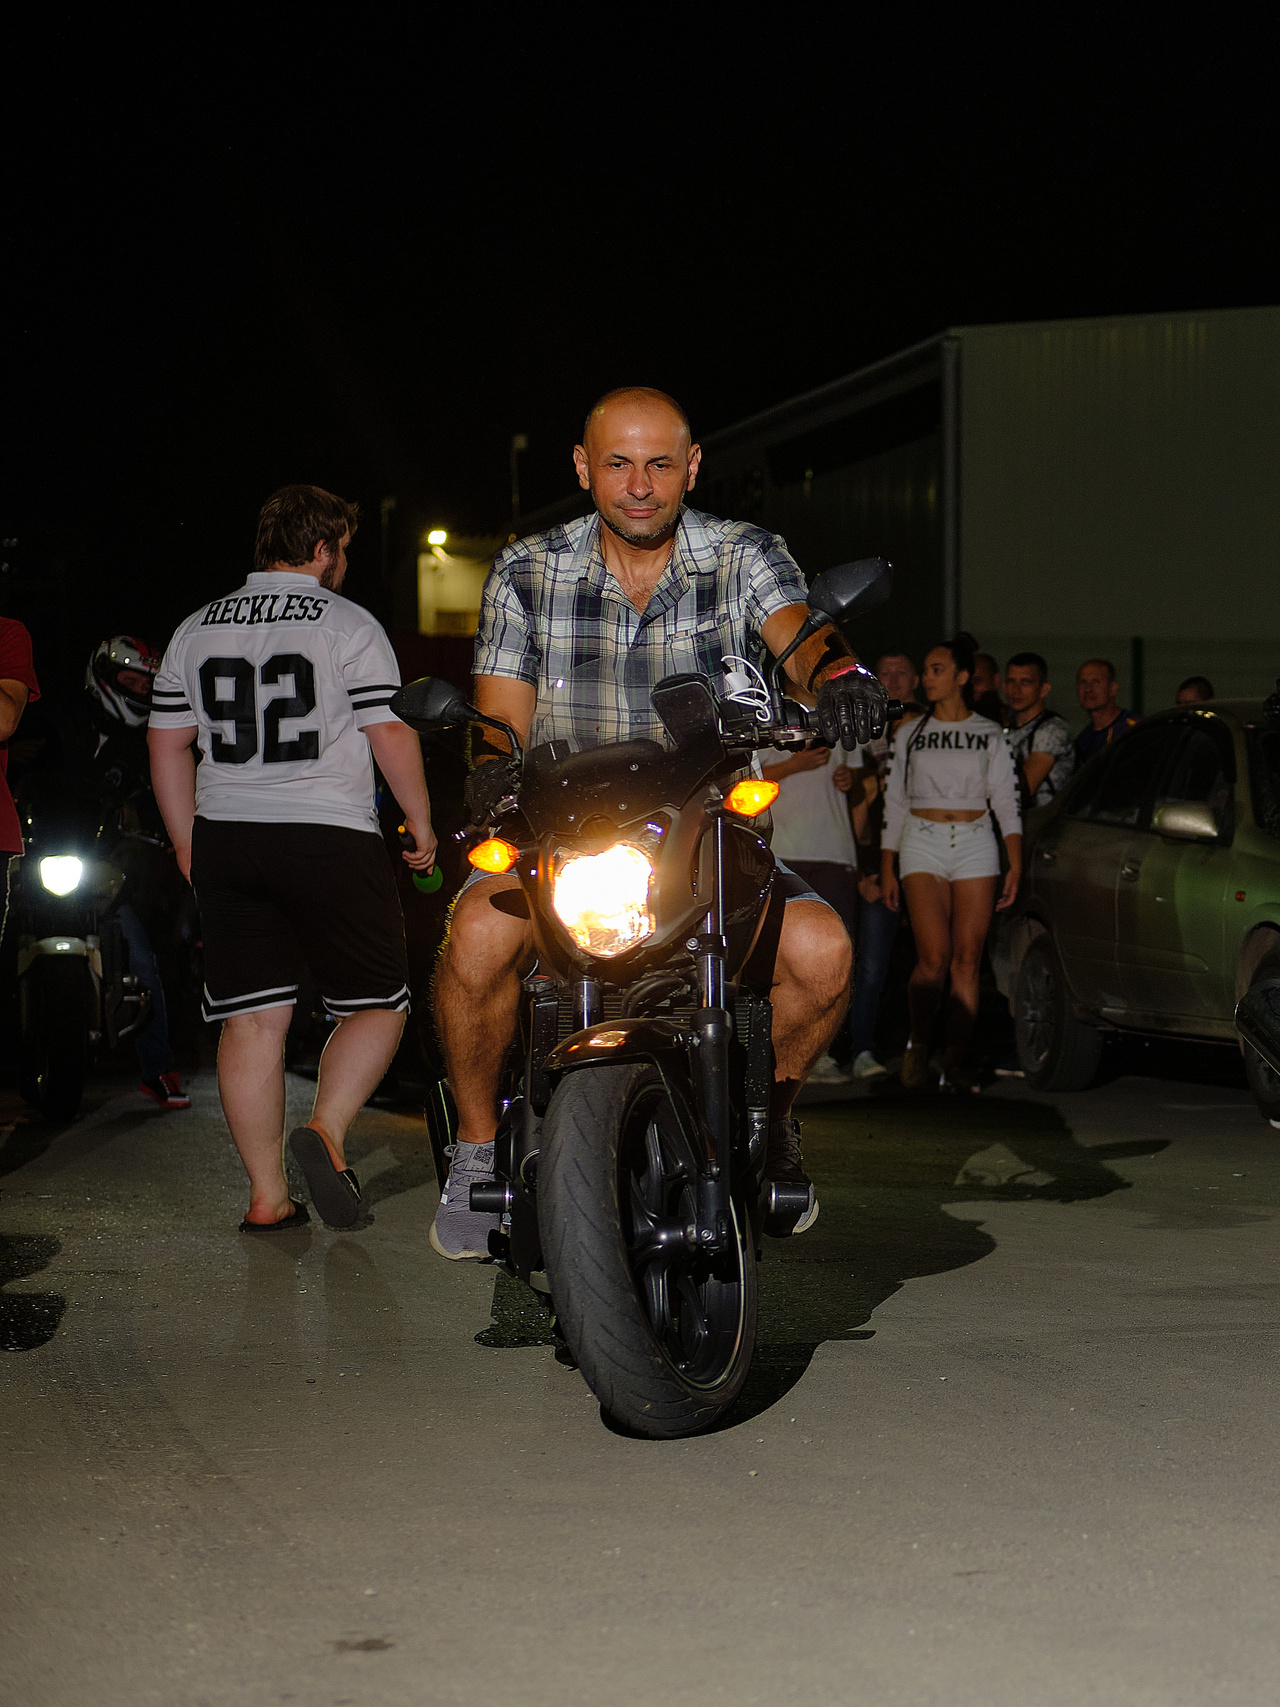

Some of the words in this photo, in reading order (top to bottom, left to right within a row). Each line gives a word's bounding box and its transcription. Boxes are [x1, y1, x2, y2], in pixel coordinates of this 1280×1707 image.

[200, 594, 328, 626] RECKLESS
[198, 652, 322, 765] 92
[914, 730, 988, 751] BRKLYN
